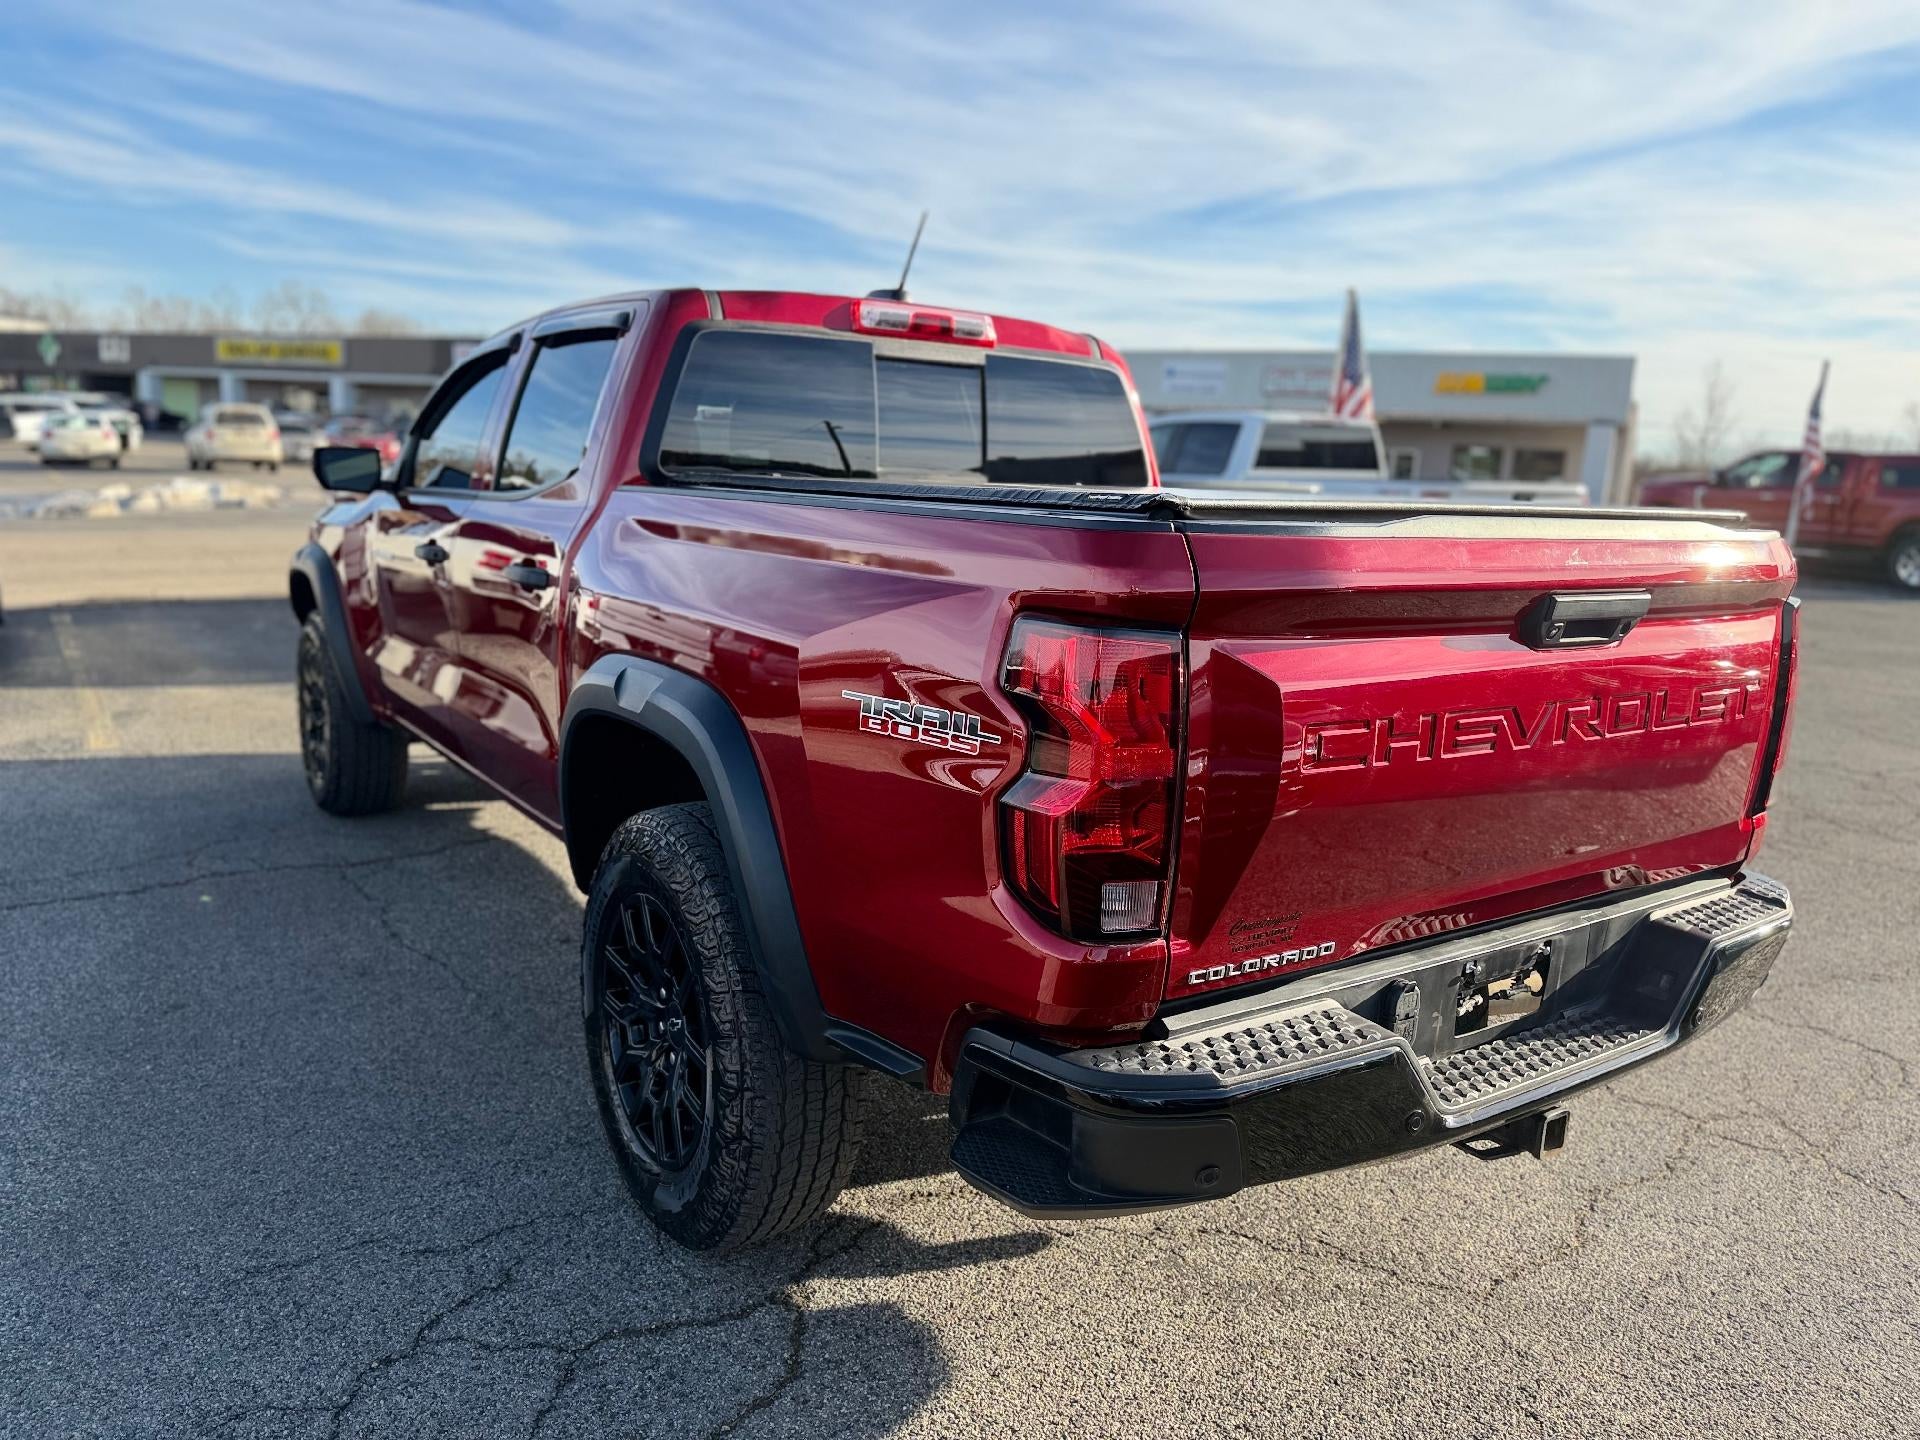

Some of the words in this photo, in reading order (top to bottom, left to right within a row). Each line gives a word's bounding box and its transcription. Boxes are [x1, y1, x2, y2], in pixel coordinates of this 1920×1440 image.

[842, 690, 1002, 744] TRAIL
[859, 714, 981, 755] BOSS
[1300, 678, 1760, 774] CHEVROLET
[1188, 941, 1336, 985] COLORADO
